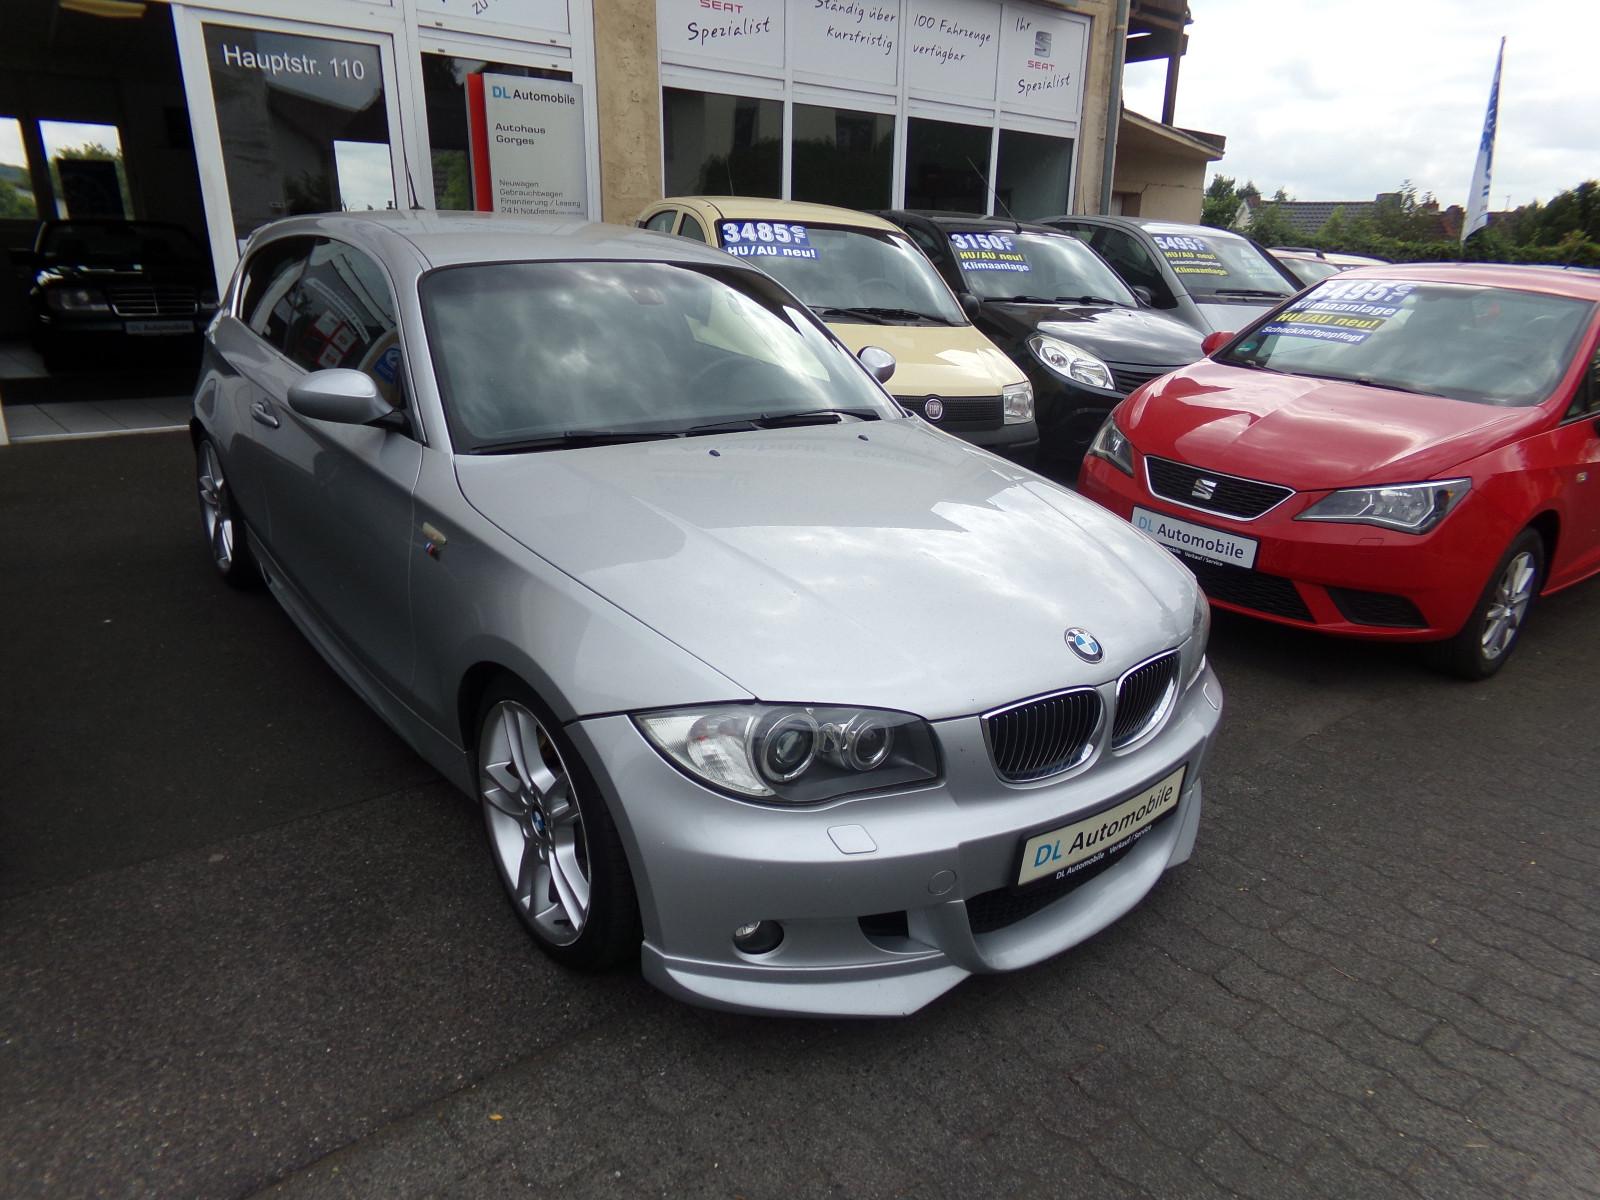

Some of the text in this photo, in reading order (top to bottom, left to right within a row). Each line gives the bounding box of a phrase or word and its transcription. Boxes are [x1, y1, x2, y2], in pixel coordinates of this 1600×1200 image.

[700, 0, 744, 14] SEAT
[869, 8, 896, 22] über
[687, 17, 770, 45] Spezialist
[914, 14, 991, 48] 100 Fahrzeuge
[1016, 17, 1032, 32] Ihr
[222, 44, 365, 80] Hauptstr. 110
[913, 44, 966, 65] verfügbar
[1027, 60, 1055, 71] SEAT
[1018, 73, 1071, 97] Spezialist
[492, 86, 576, 105] DL Automobile
[495, 123, 546, 134] Autohaus
[496, 135, 535, 146] Gorges
[499, 180, 540, 189] Neuwagen
[727, 246, 816, 258] HU/AU neu!
[962, 261, 1030, 272] Klimaanlage
[1290, 299, 1397, 316] Klimaanlage
[1336, 317, 1380, 329] neu!
[1138, 516, 1244, 559] DL Automobile
[1034, 785, 1173, 868] DL Automobile
[1056, 870, 1065, 880] DL
[1066, 851, 1105, 876] Automobile
